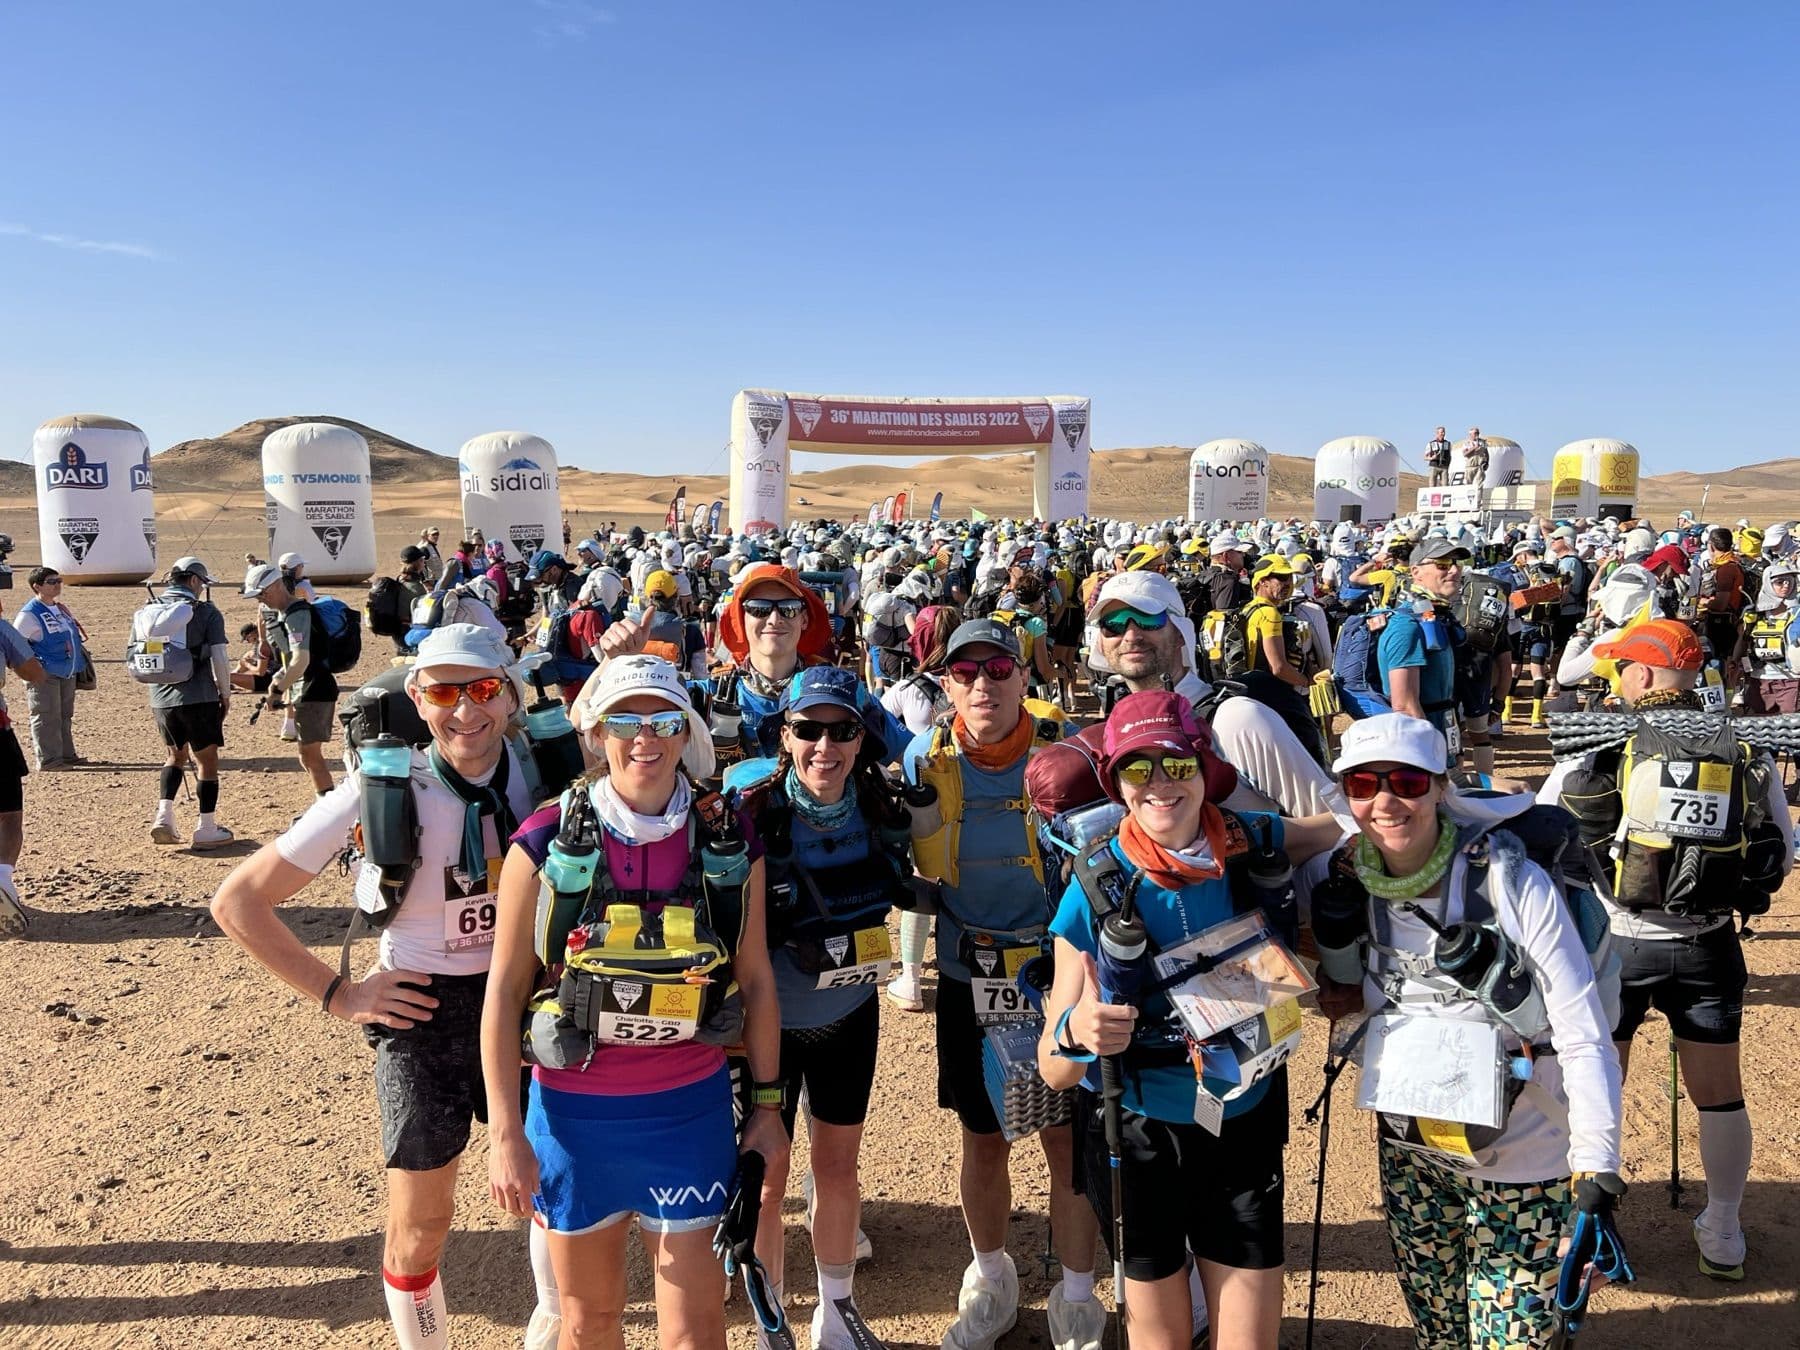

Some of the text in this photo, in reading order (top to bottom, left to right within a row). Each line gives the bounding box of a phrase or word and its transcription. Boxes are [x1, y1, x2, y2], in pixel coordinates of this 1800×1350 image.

[852, 411, 918, 426] MARATHON
[920, 412, 942, 426] DES
[944, 412, 988, 426] SABLES
[990, 412, 1020, 426] 2022
[868, 428, 980, 438] www.marathondessables.com
[49, 468, 104, 484] DARI
[292, 474, 361, 484] TV5MONDE
[139, 658, 157, 669] 851
[614, 672, 670, 684] RAIDLIGHT
[1670, 798, 1718, 826] 735
[465, 898, 487, 906] Kevin
[459, 904, 497, 934] 69
[478, 934, 494, 944] MD
[615, 1016, 654, 1025] Charlotte
[614, 1022, 680, 1040] 522
